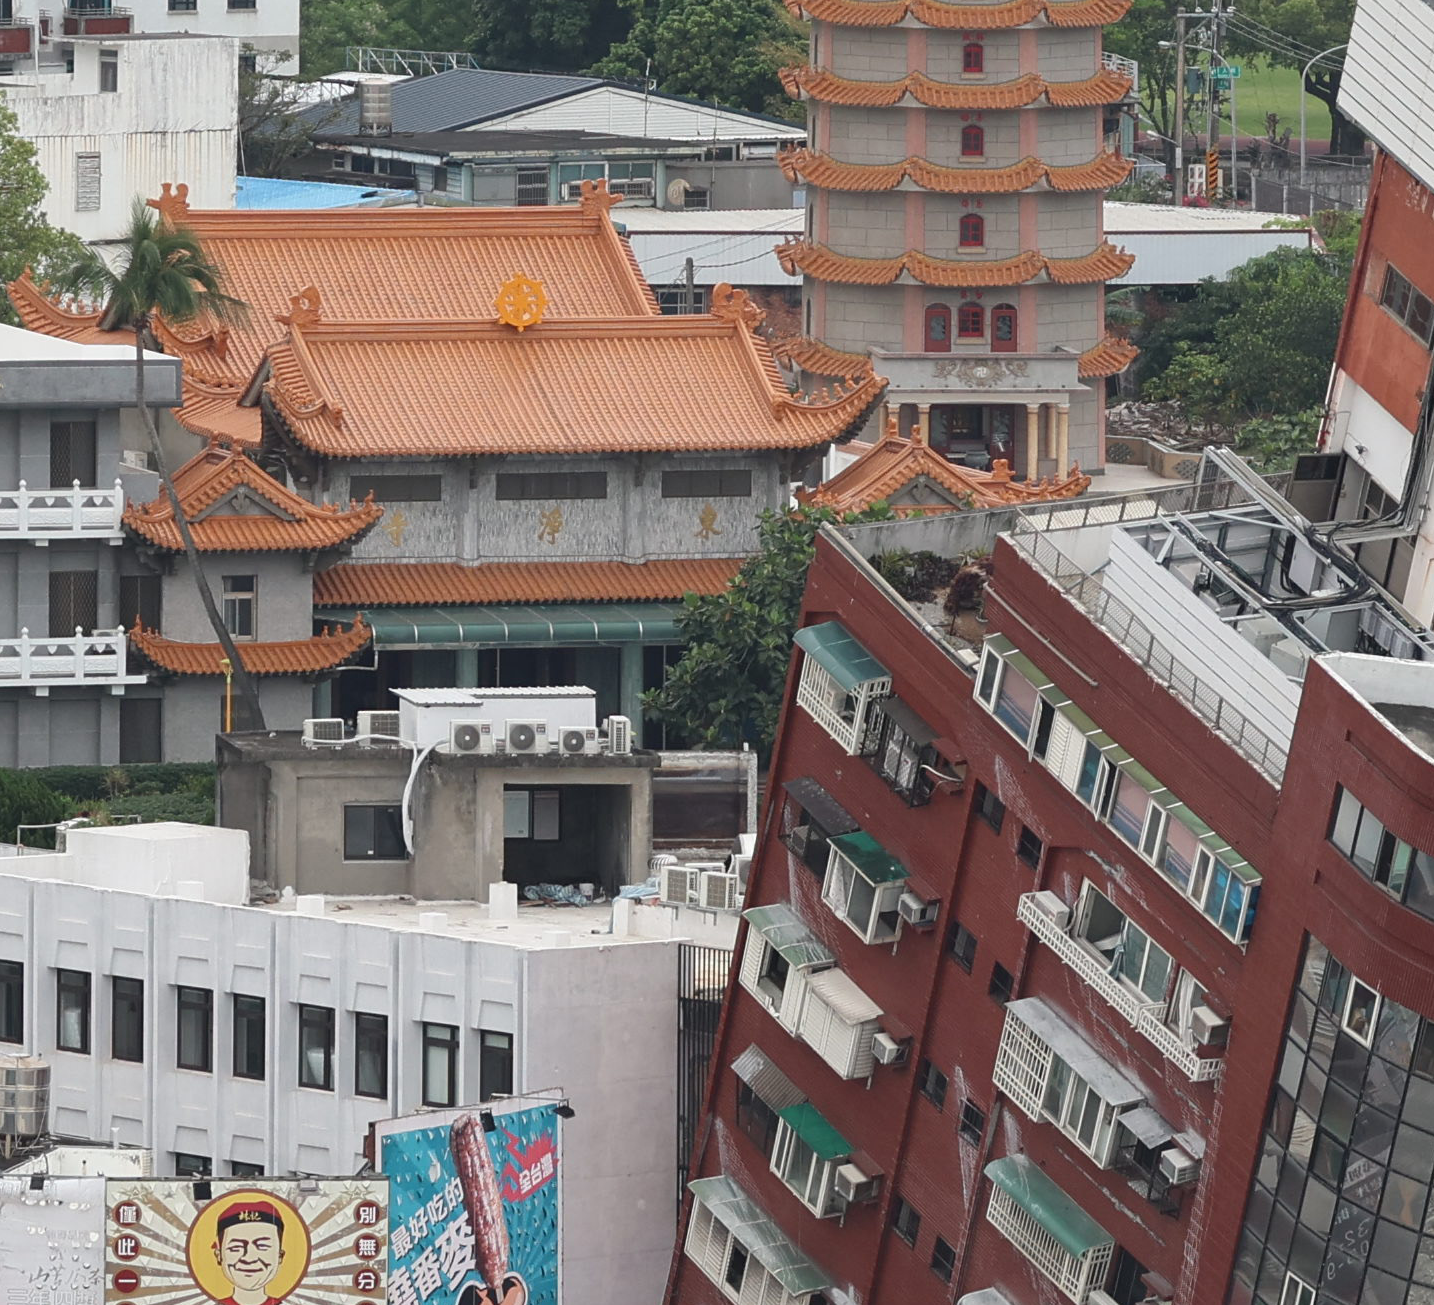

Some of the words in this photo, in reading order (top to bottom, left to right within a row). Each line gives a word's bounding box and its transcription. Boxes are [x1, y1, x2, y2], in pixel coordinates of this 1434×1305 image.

[519, 1154, 554, 1196] 全台灣
[390, 1177, 465, 1262] 最好吃的
